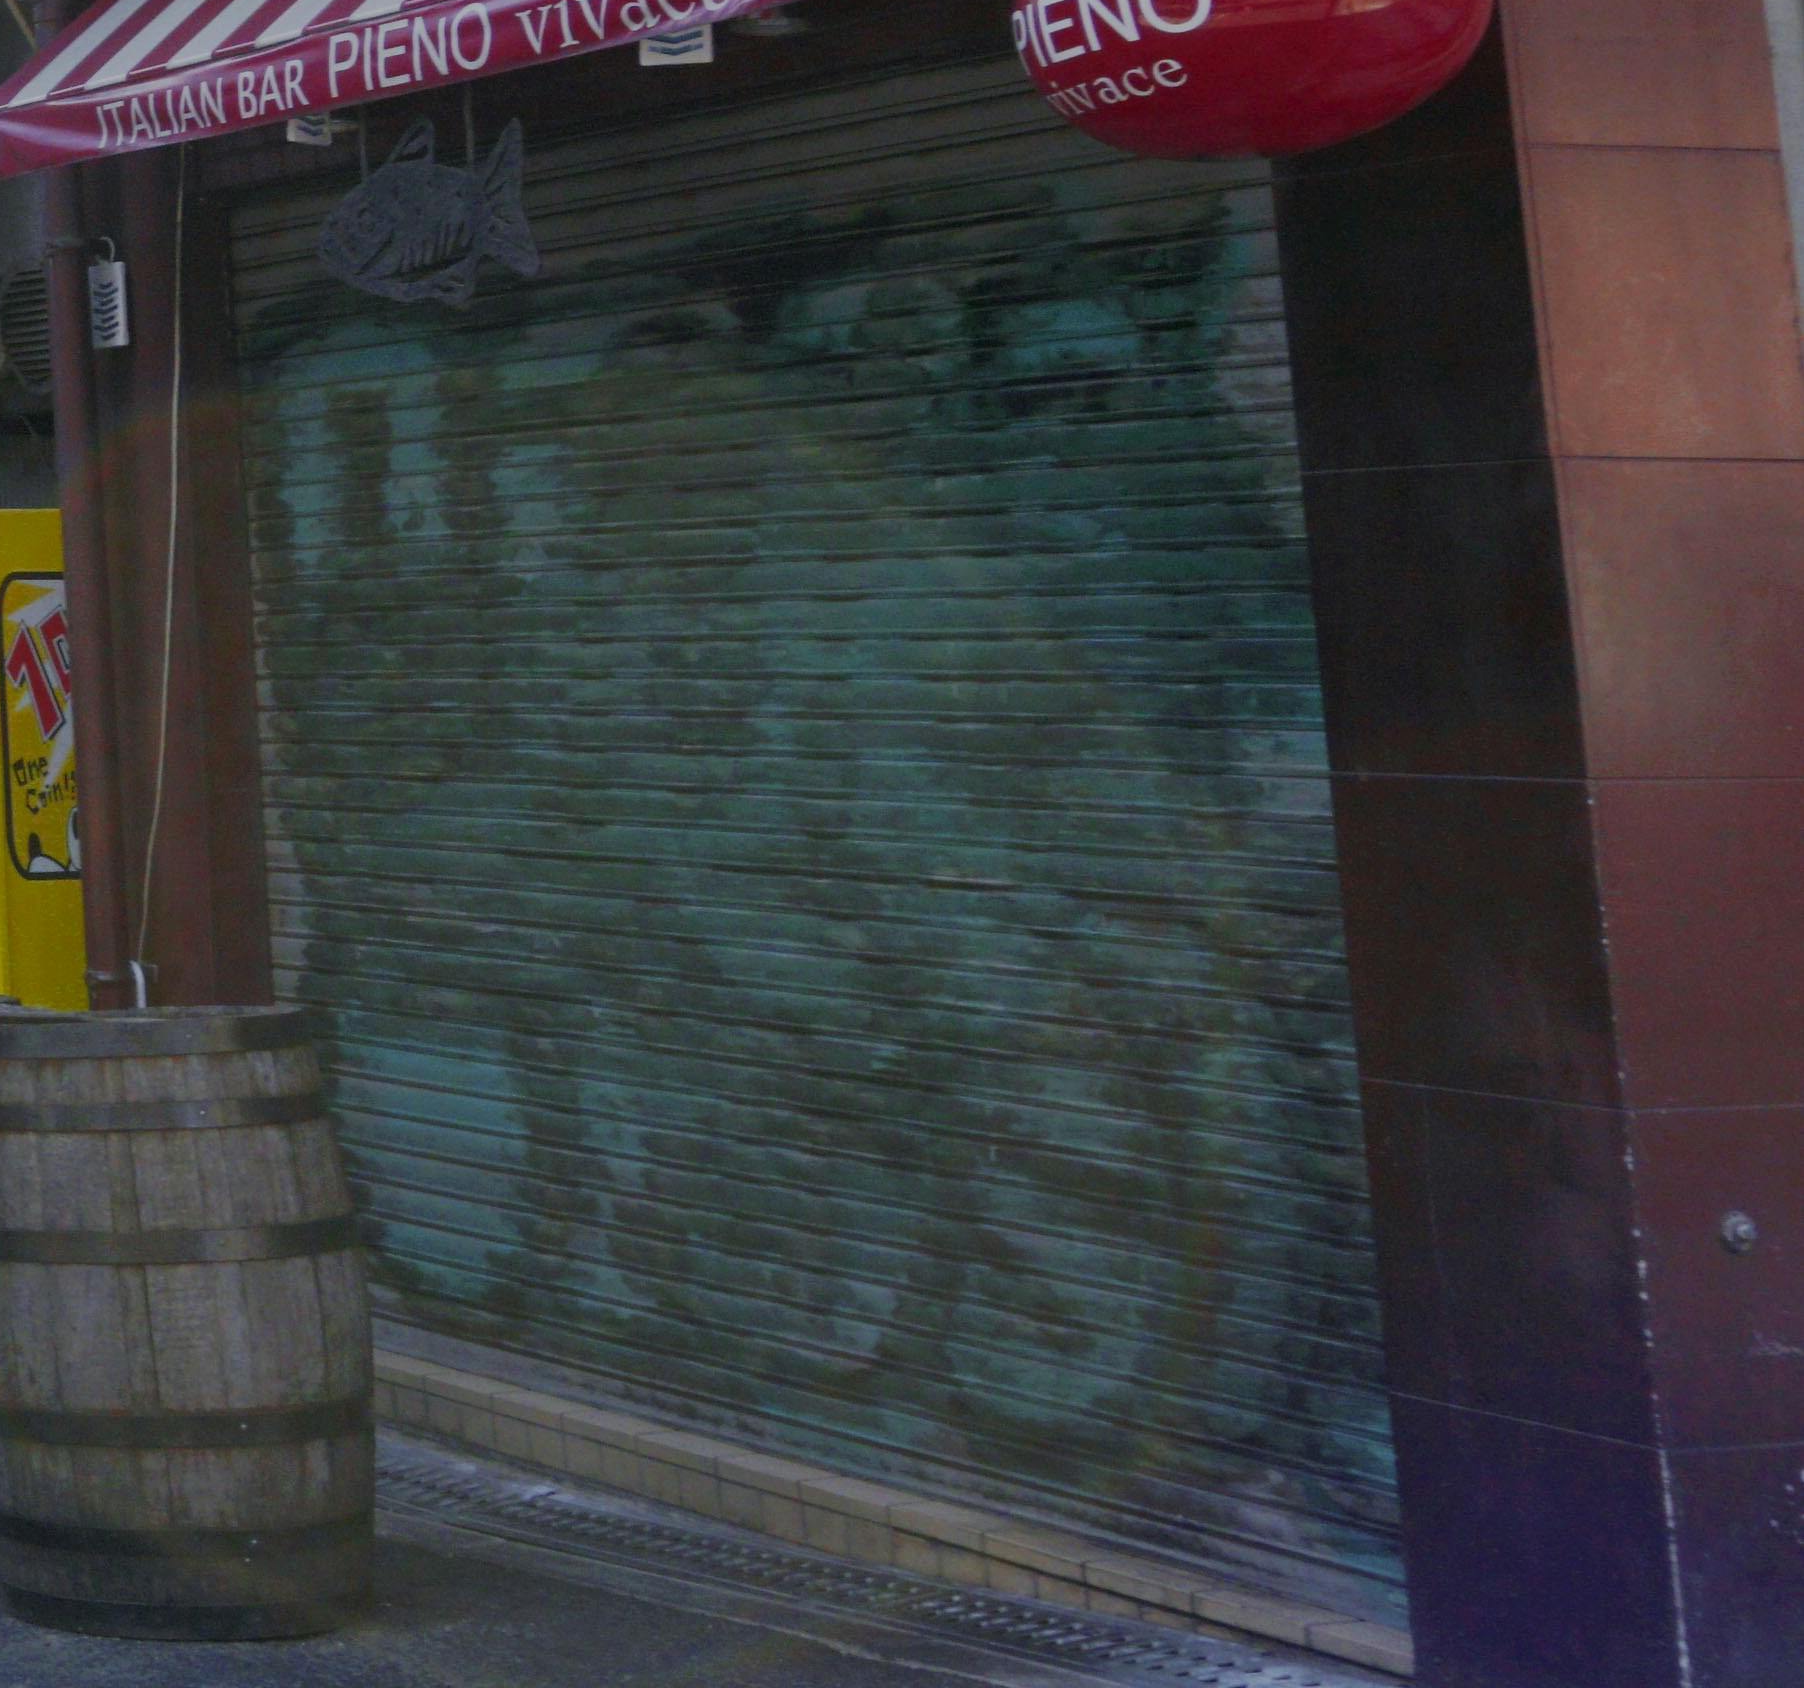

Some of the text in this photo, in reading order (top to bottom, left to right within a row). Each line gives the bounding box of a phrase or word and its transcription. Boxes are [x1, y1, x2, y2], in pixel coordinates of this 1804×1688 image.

[97, 76, 227, 150] ITALIAN
[237, 59, 309, 121] BAR
[328, 3, 493, 100] PIENO
[1045, 55, 1189, 117] vivace
